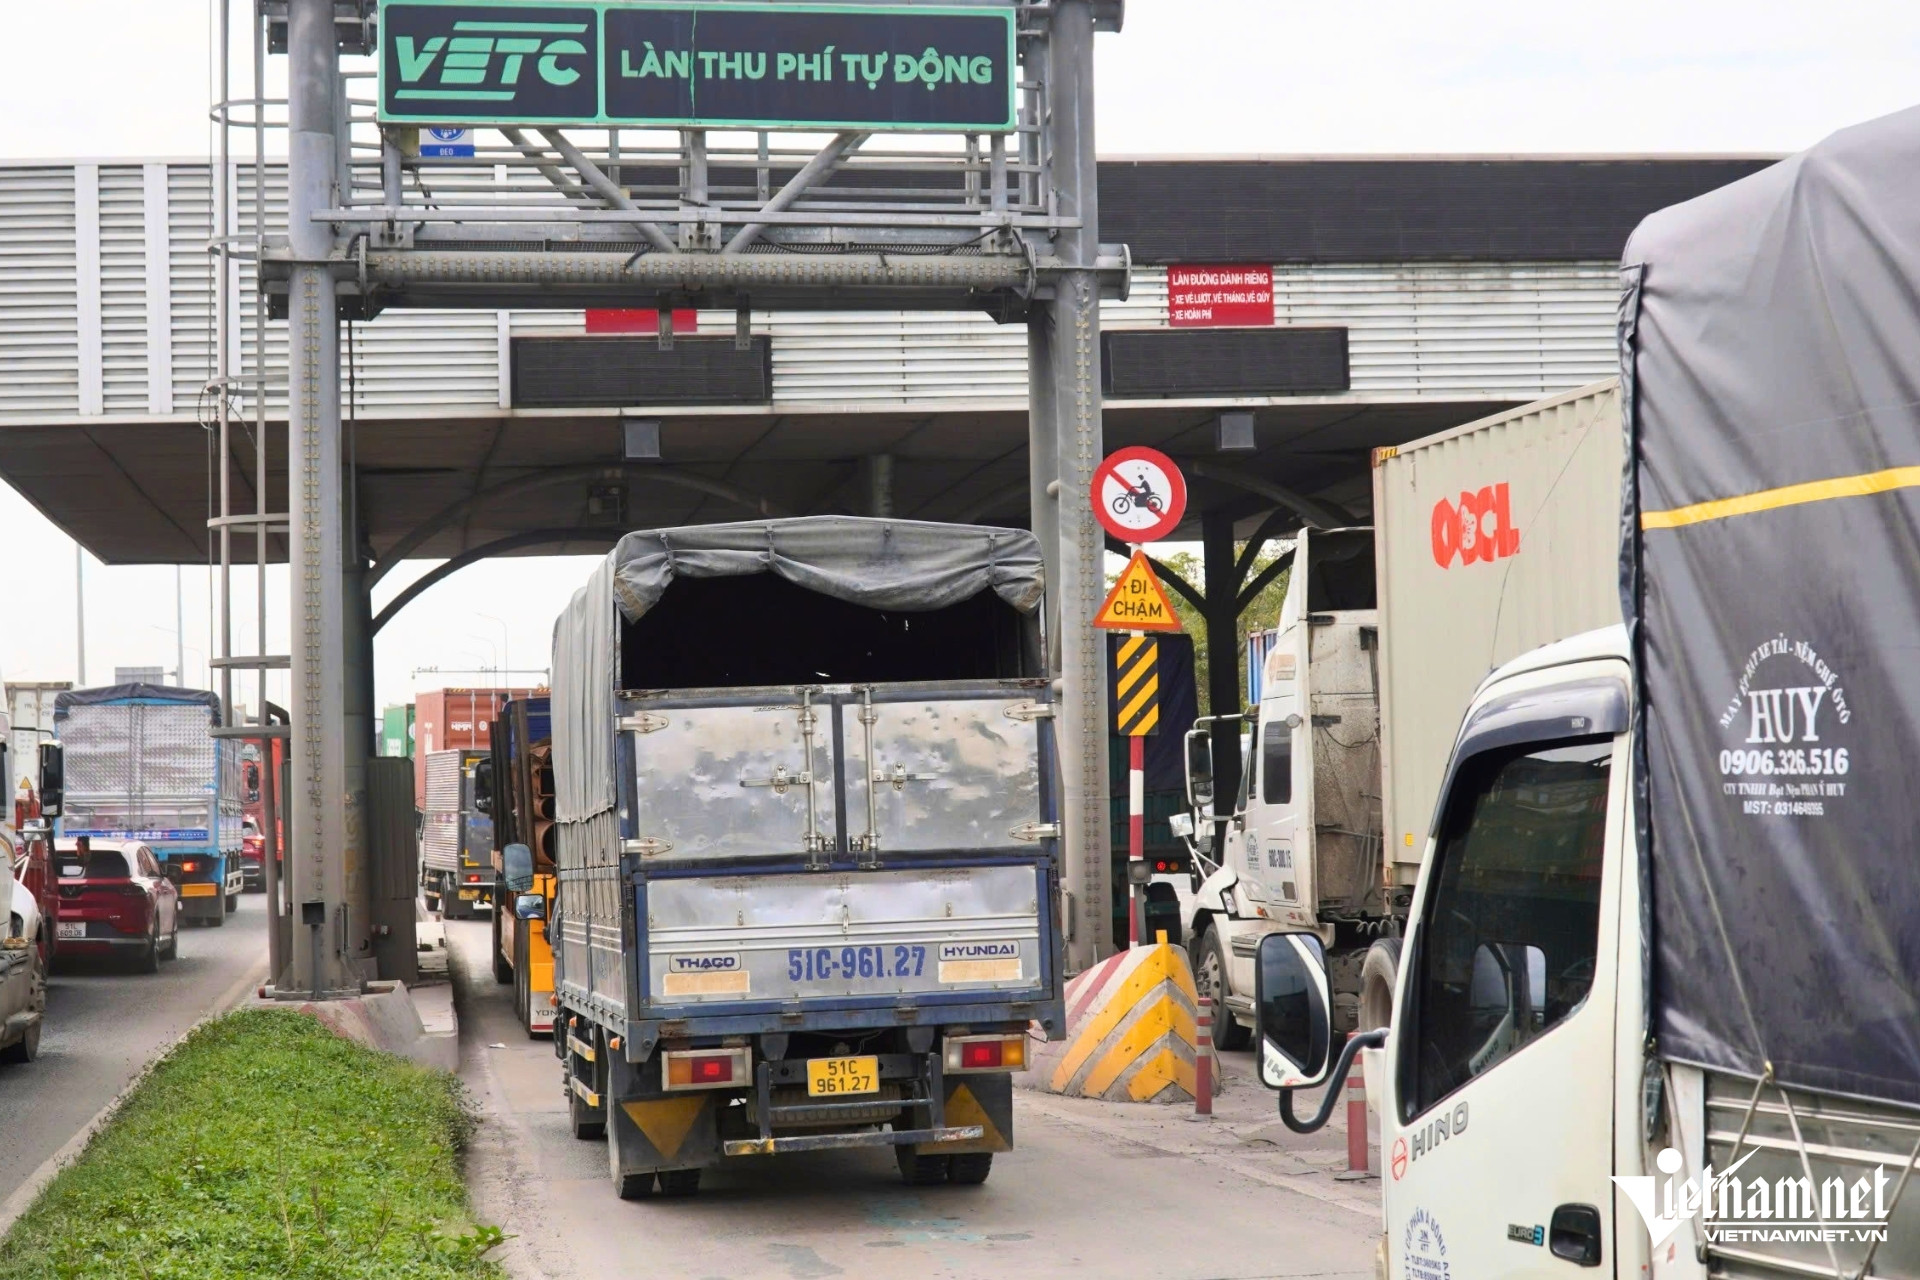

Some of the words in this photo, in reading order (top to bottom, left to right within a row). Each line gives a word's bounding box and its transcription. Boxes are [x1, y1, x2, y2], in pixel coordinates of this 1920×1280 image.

[395, 36, 587, 86] VETC
[621, 41, 689, 78] LÀN
[698, 51, 766, 80] THU
[777, 45, 835, 81] PHÍ
[841, 51, 888, 90] TỰ
[894, 47, 992, 91] ĐỘNG
[1172, 270, 1189, 286] LÀN
[1190, 269, 1219, 286] ĐƯỜNG
[1220, 270, 1243, 285] DÀNH
[1244, 270, 1268, 285] RIÊNG
[1130, 579, 1147, 595] ĐI
[1113, 598, 1162, 621] CHẬM
[1745, 687, 1827, 744] HUY
[1719, 748, 1849, 775] 0906.326.516
[1743, 800, 1772, 815] MST:
[944, 944, 1015, 956] HYUNDAI
[675, 956, 735, 970] THACO
[788, 946, 926, 982] 51C-961.27
[827, 1060, 858, 1075] 51C
[816, 1077, 871, 1093] 961.27
[1412, 1101, 1469, 1162] HINO
